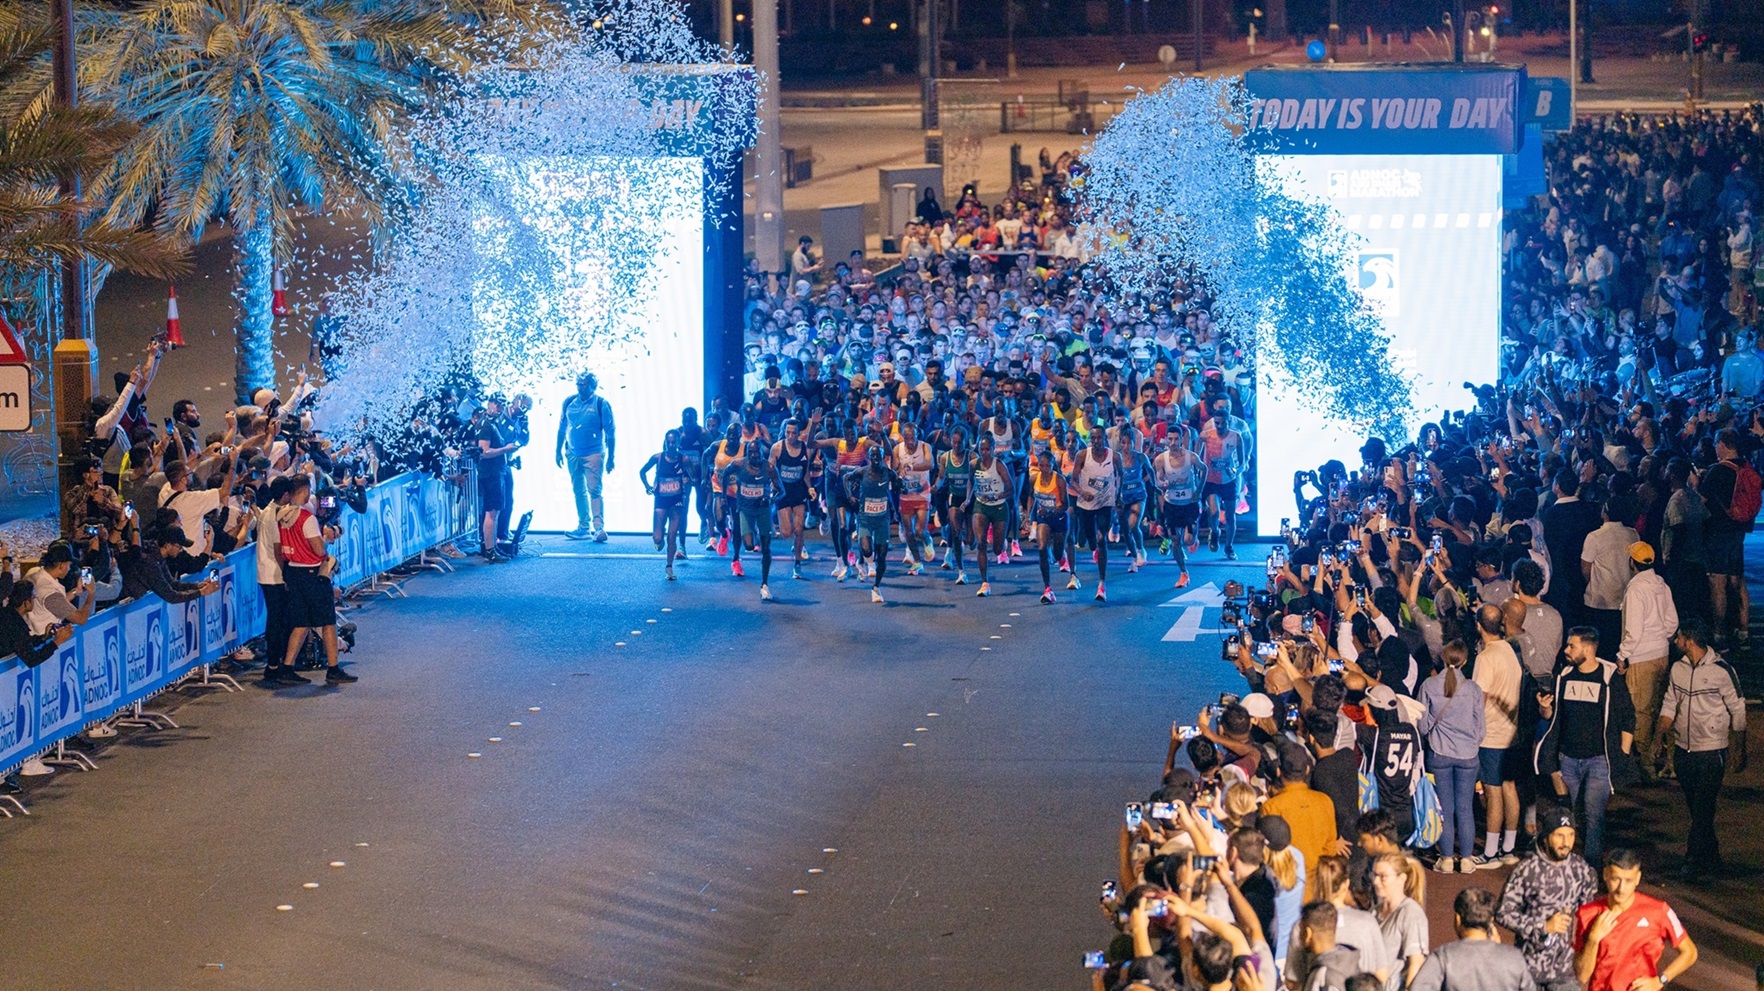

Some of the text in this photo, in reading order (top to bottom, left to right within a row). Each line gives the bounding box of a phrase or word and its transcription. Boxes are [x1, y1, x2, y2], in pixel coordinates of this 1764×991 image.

[1249, 98, 1508, 129] TODAY IS YOUR DAY
[1535, 90, 1552, 116] B
[1350, 169, 1401, 179] ADNOC
[84, 682, 108, 705] ADNOC
[1568, 685, 1595, 698] A X
[1384, 742, 1413, 777] 54
